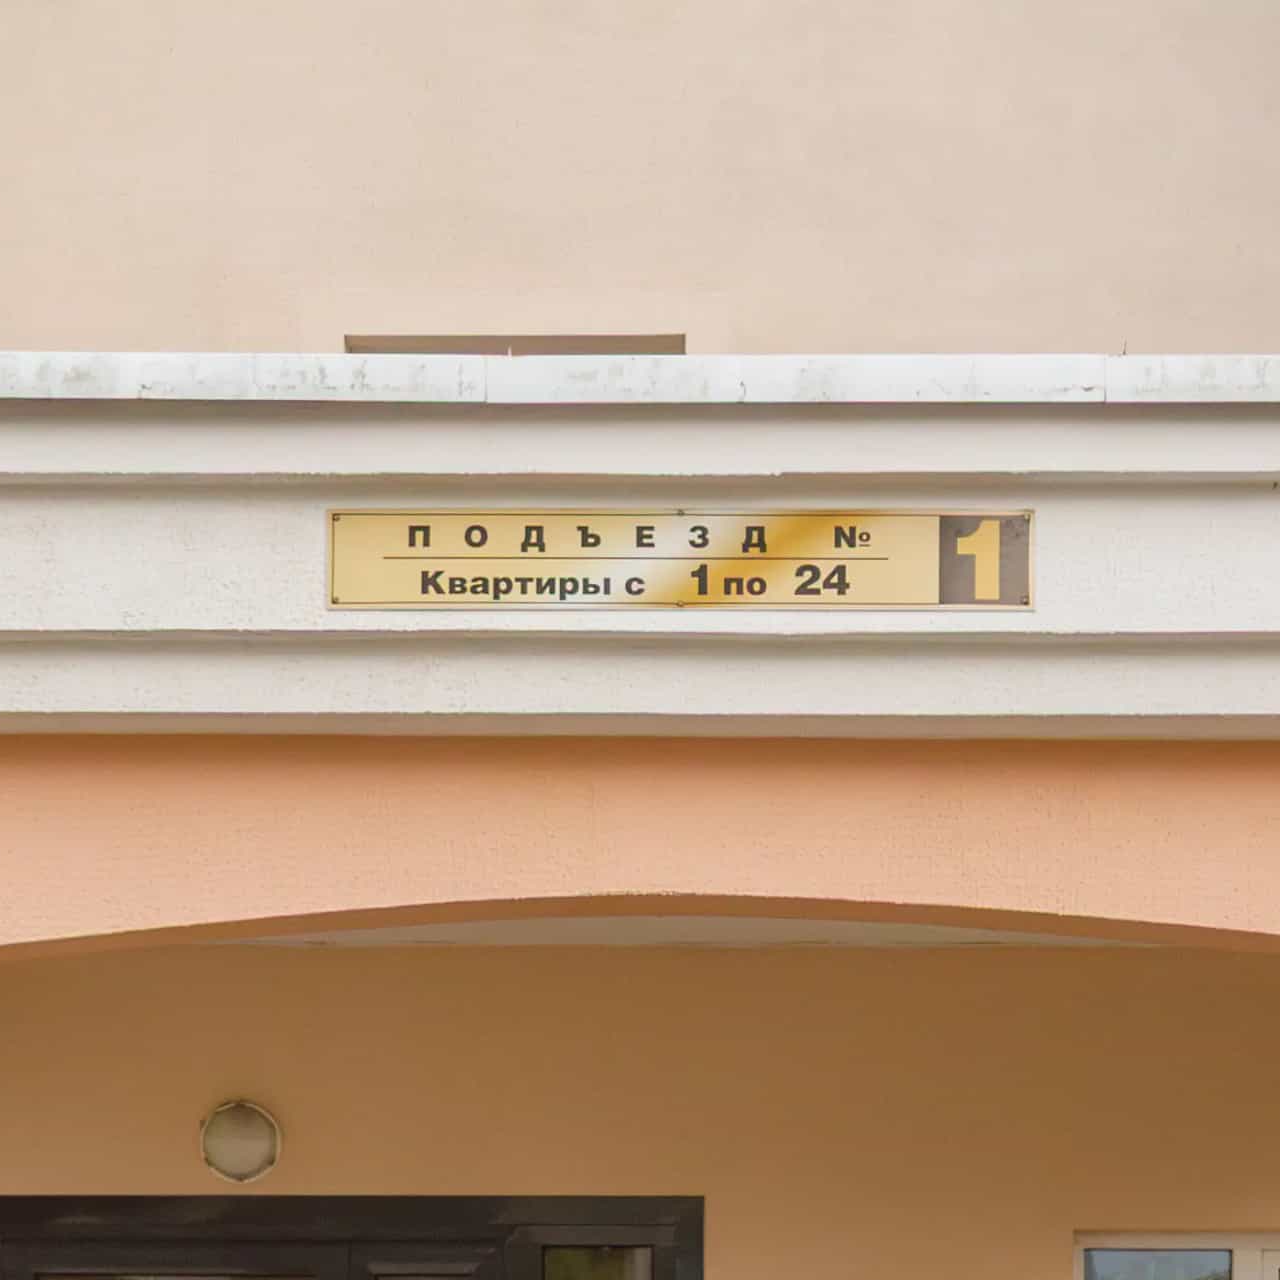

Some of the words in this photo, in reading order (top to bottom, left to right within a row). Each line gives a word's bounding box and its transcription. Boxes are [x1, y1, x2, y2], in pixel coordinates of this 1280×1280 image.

[408, 525, 768, 553] ПОДЪЕЗД
[834, 525, 871, 548] №
[956, 519, 1001, 600] 1
[421, 570, 611, 600] Квартиры
[625, 577, 645, 596] с
[690, 563, 708, 596] 1
[723, 576, 767, 596] по
[794, 564, 850, 596] 24
